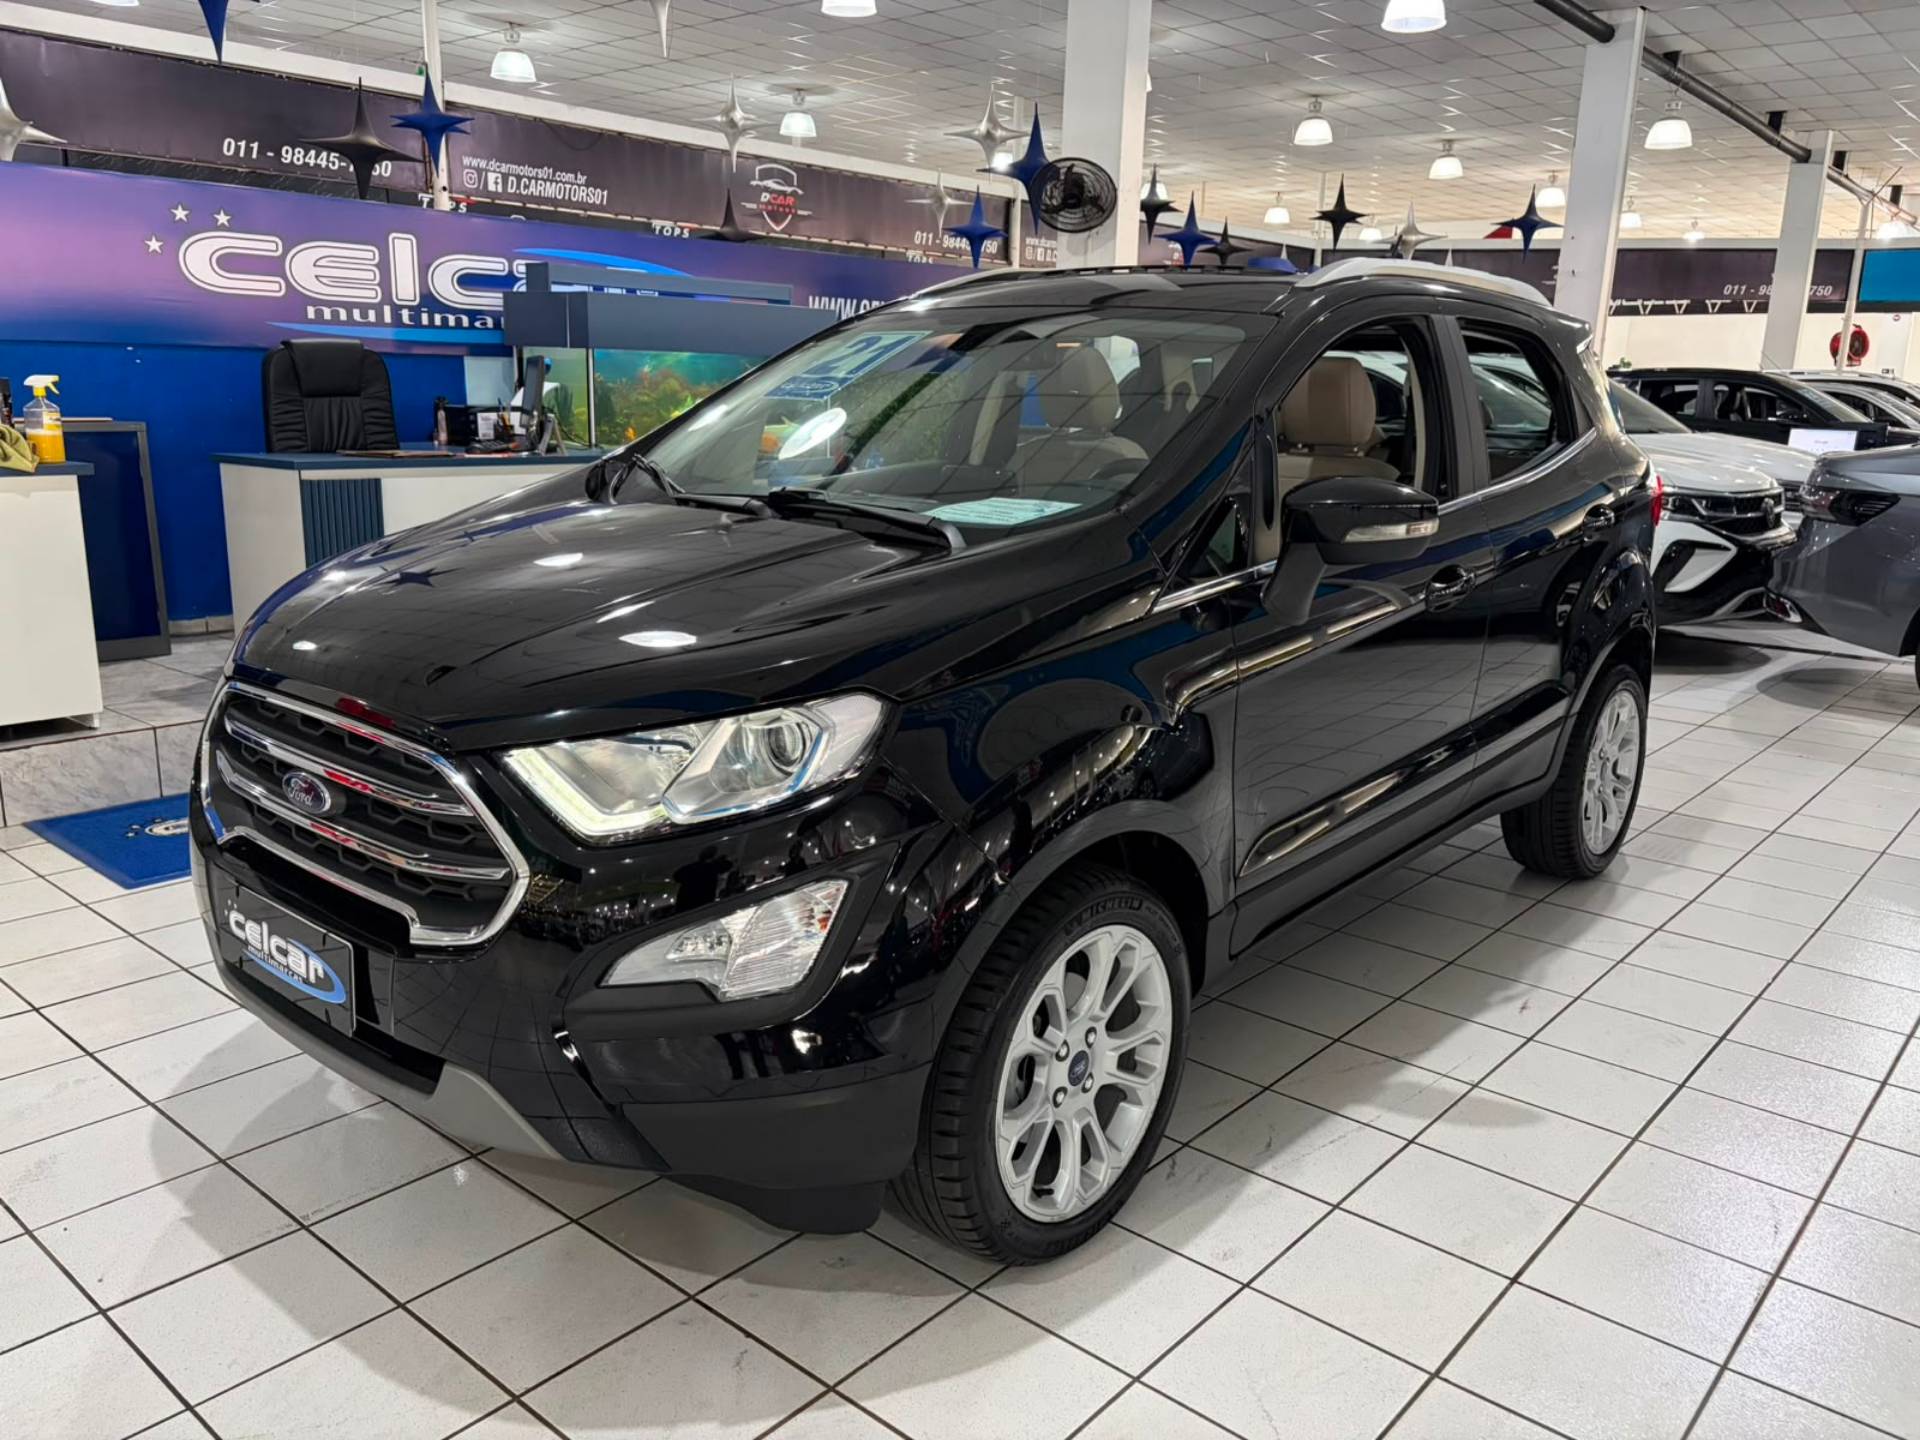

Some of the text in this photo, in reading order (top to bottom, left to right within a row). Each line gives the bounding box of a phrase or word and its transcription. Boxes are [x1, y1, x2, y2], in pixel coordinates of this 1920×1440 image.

[222, 137, 260, 160] 011
[462, 155, 588, 184] www.dcarmotors01.com.br
[507, 175, 609, 206] D.CARMOTORS01
[421, 197, 468, 213] TPS
[654, 225, 690, 238] TOPS
[914, 231, 933, 246] 011
[178, 231, 541, 311] celc
[1723, 284, 1746, 296] 011
[306, 304, 503, 330] multima
[802, 335, 918, 376] 21
